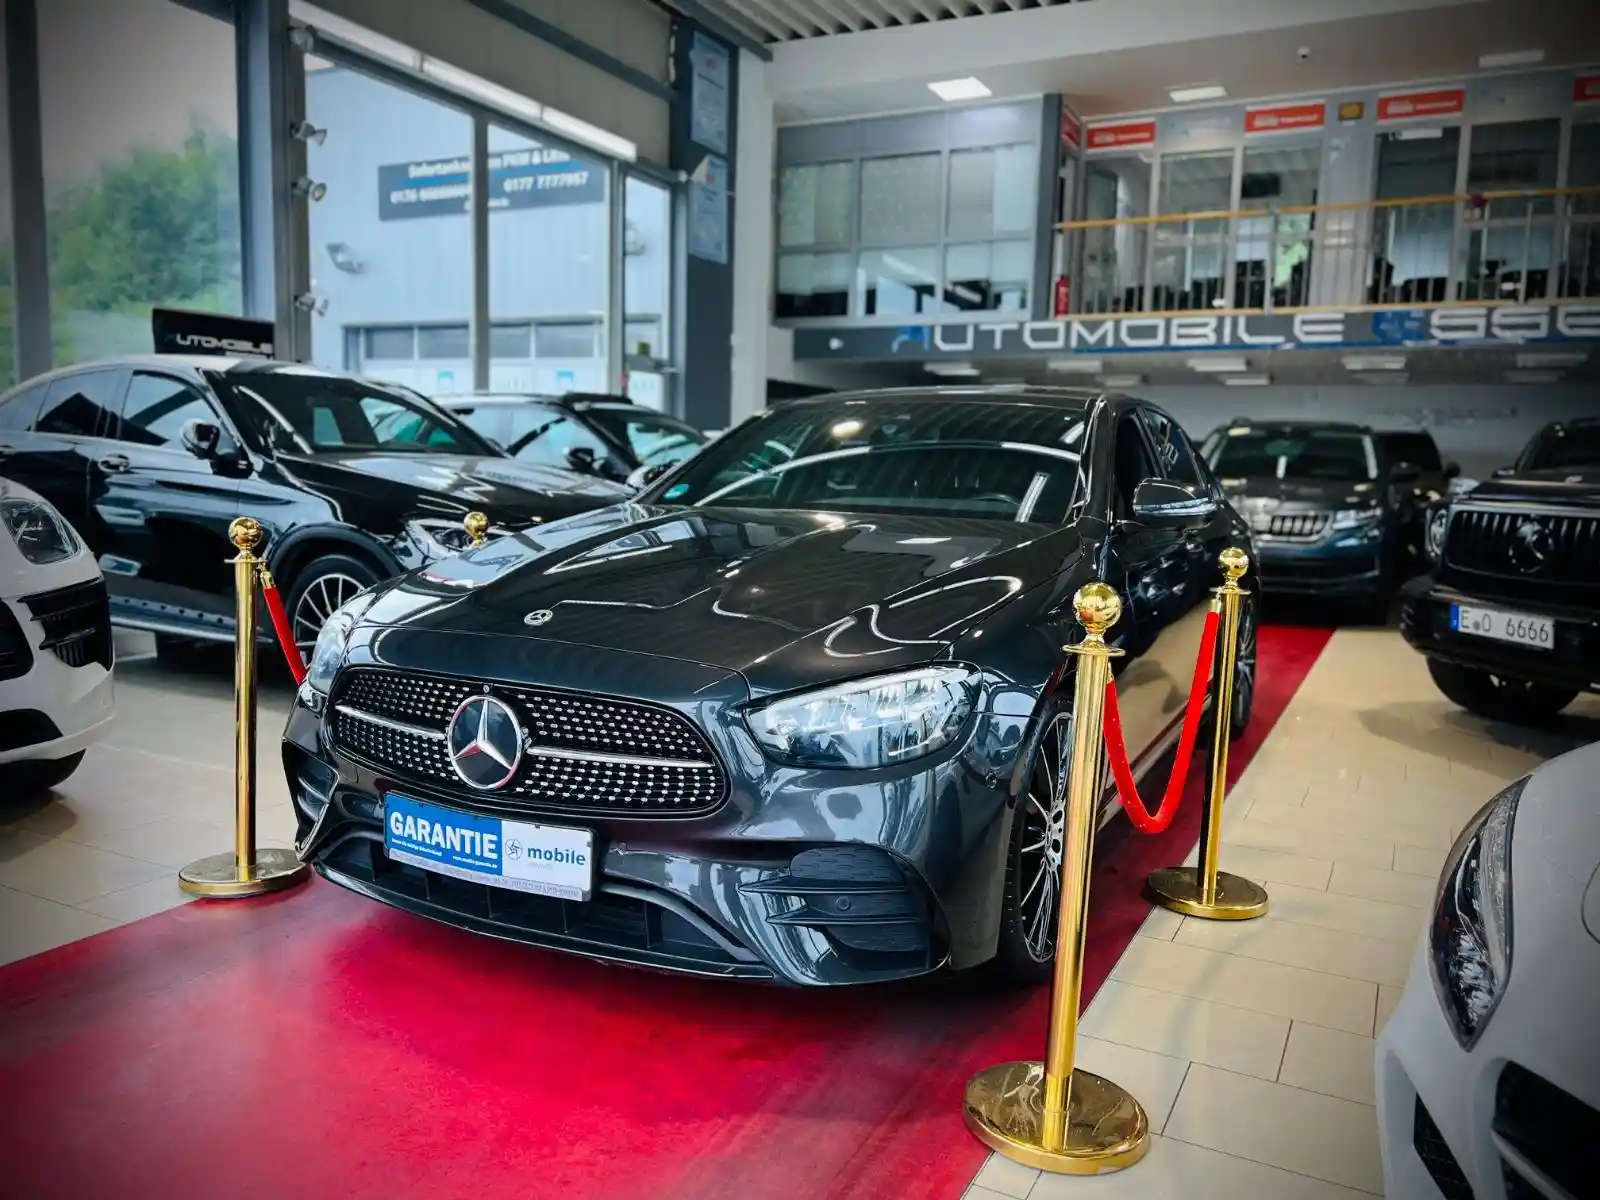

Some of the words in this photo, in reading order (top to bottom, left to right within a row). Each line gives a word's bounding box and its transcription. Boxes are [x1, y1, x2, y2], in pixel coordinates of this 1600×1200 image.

[891, 313, 1345, 354] AUTOMOBILE
[1461, 609, 1470, 630] E
[1505, 618, 1549, 643] 6666
[390, 811, 498, 859] GARANTIE
[528, 847, 586, 866] mobile
